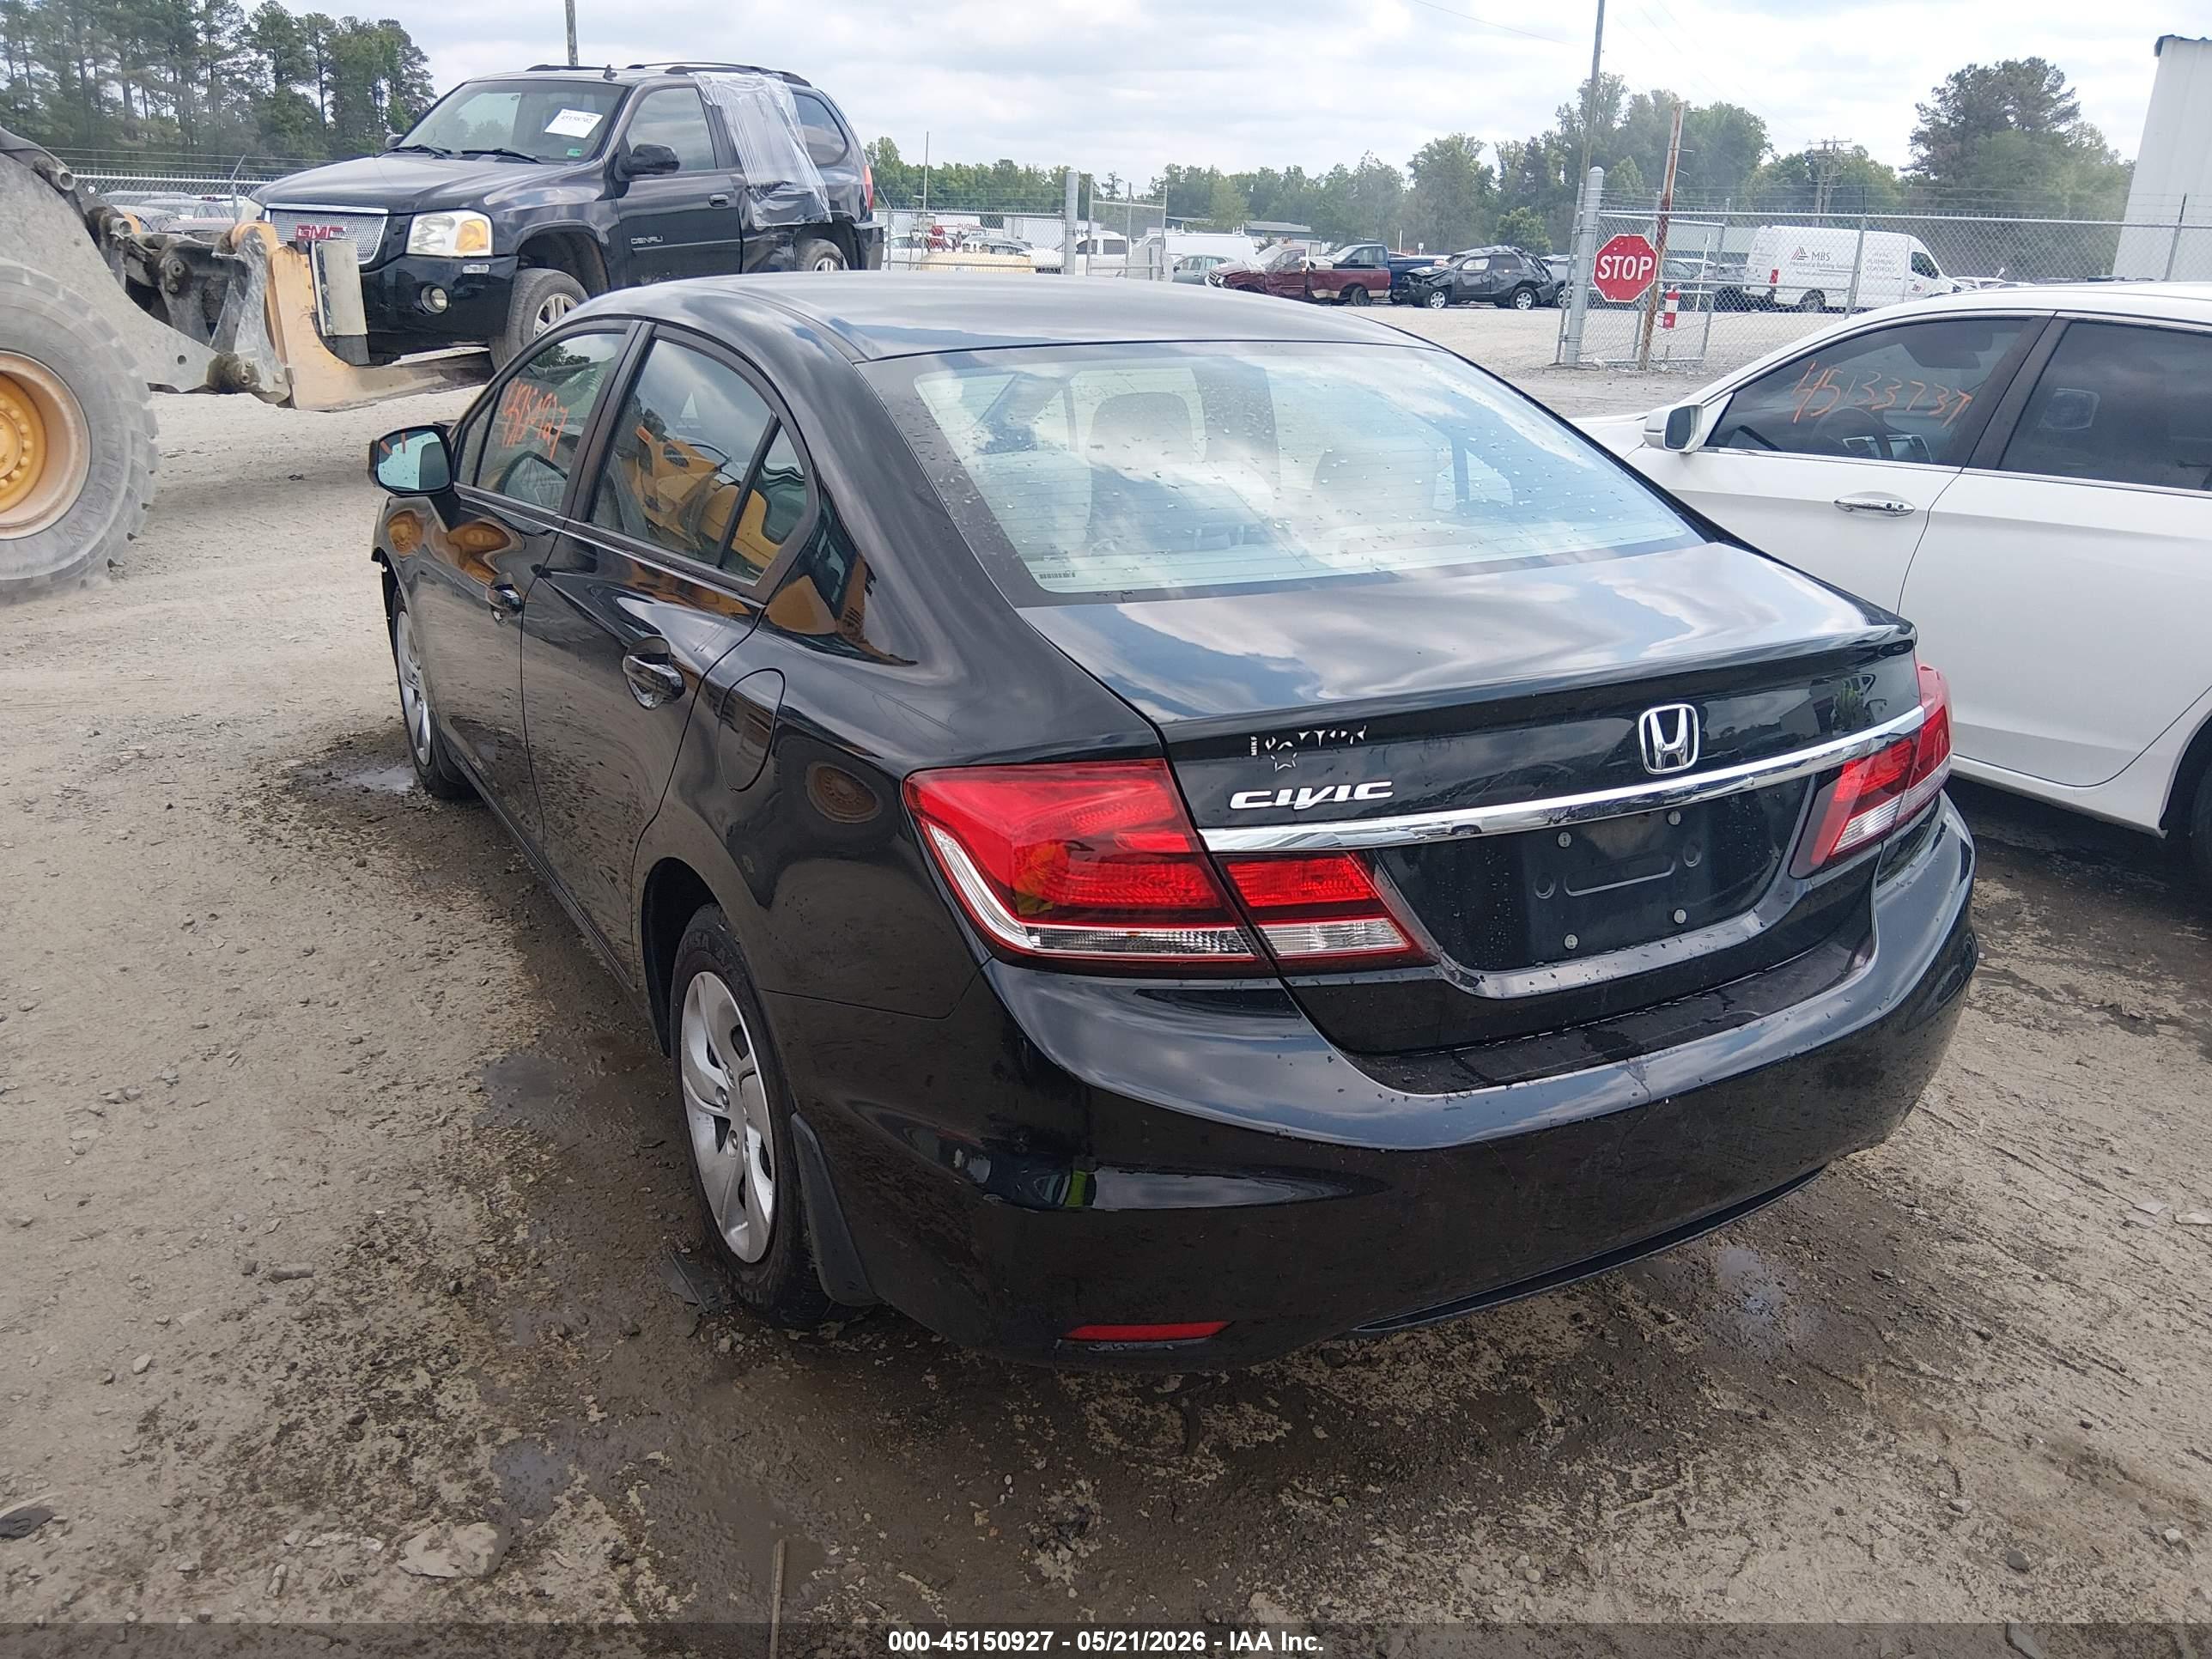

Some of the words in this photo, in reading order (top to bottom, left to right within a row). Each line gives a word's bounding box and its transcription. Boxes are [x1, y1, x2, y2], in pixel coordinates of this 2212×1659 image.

[295, 224, 346, 240] GMC
[1597, 254, 1654, 281] STOP
[1811, 252, 1831, 261] MBS
[1791, 360, 1972, 428] 45133737
[1229, 780, 1394, 811] CIVIC
